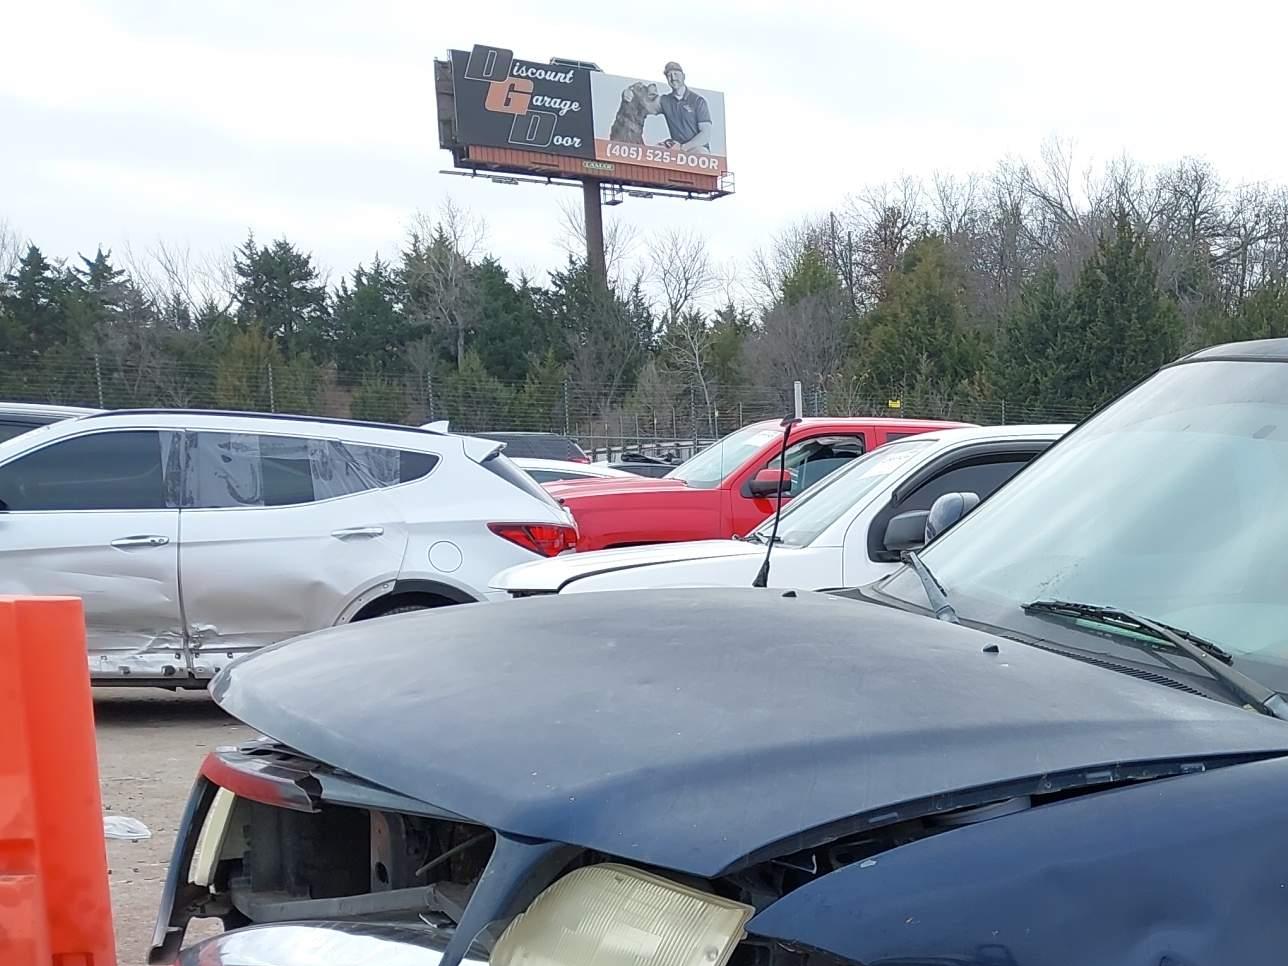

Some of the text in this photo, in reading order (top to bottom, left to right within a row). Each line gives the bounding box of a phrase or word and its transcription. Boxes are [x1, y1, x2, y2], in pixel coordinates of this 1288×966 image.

[464, 44, 575, 83] Discount
[485, 75, 581, 116] Garage
[508, 109, 582, 147] Door
[606, 143, 719, 170] (405) 525-DOOR
